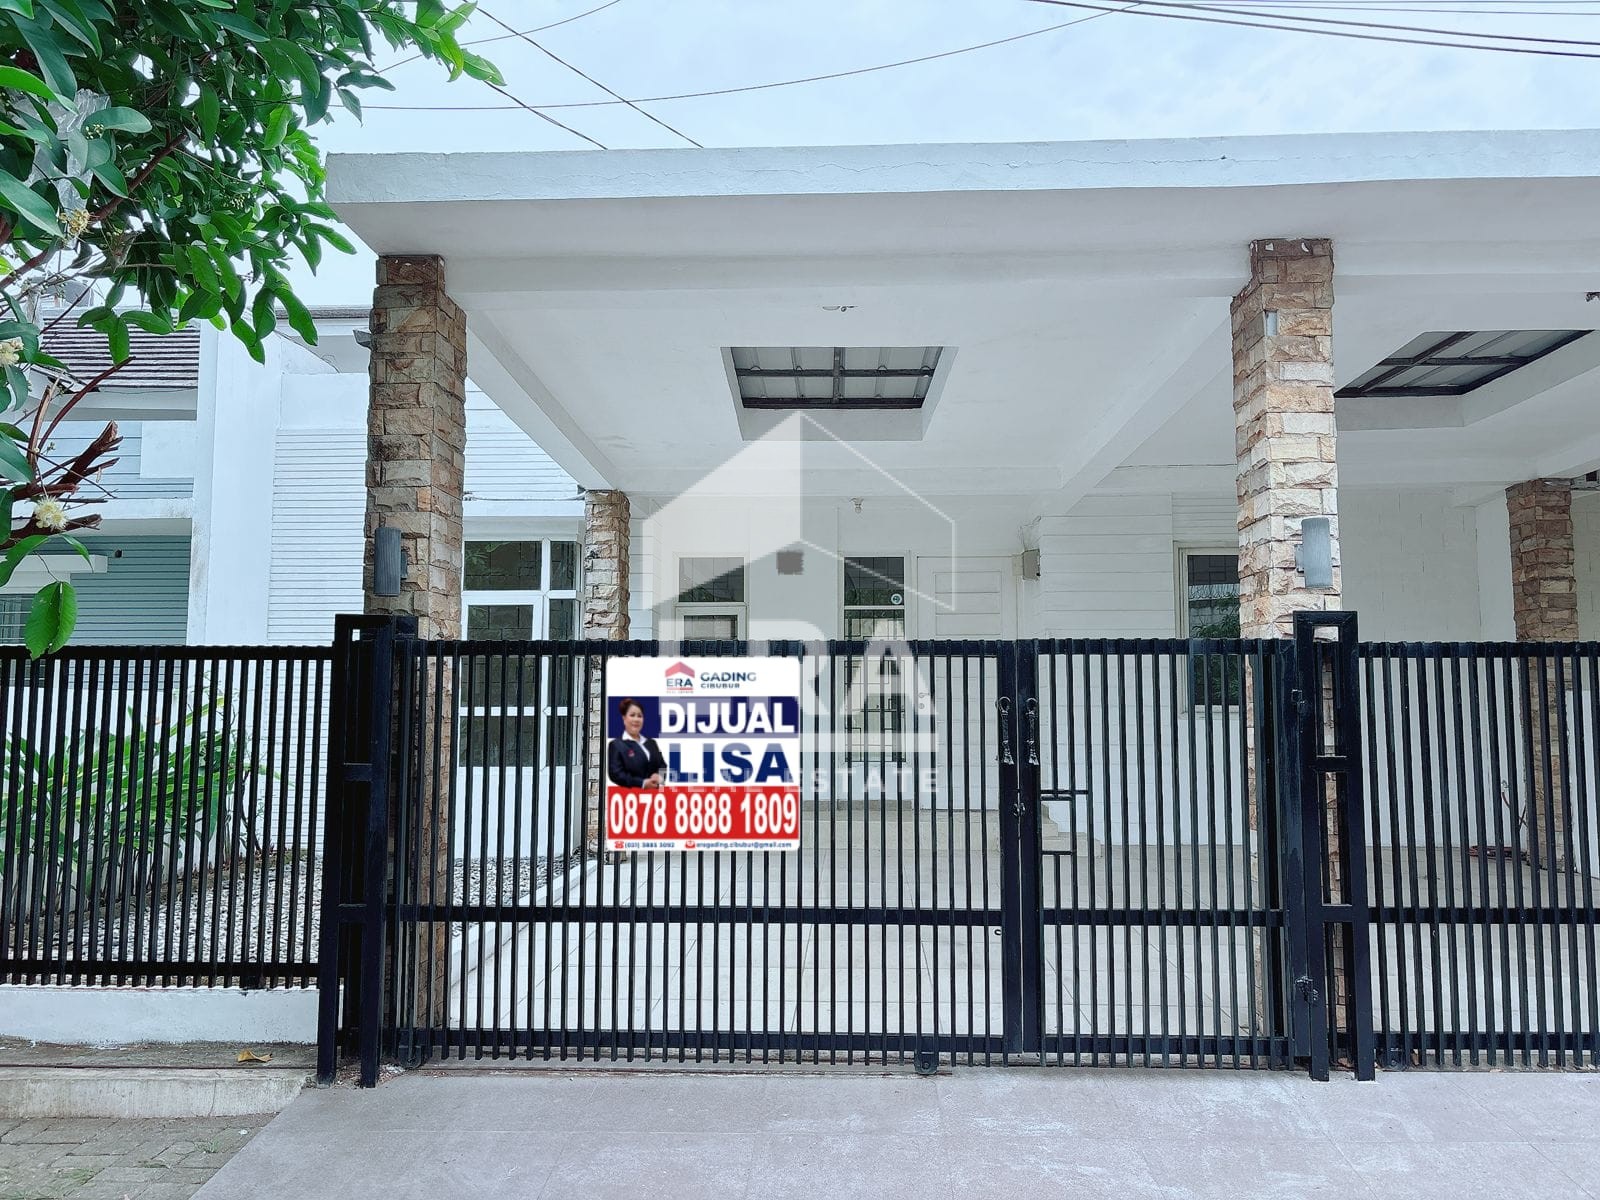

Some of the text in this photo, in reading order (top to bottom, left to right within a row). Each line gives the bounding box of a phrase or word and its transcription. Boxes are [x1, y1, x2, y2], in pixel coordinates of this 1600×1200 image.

[666, 678, 693, 687] ERA
[700, 671, 757, 682] GADING
[661, 702, 795, 734] DIJUAL
[668, 742, 794, 784] LISA
[610, 793, 797, 834] 0878 8888 1809
